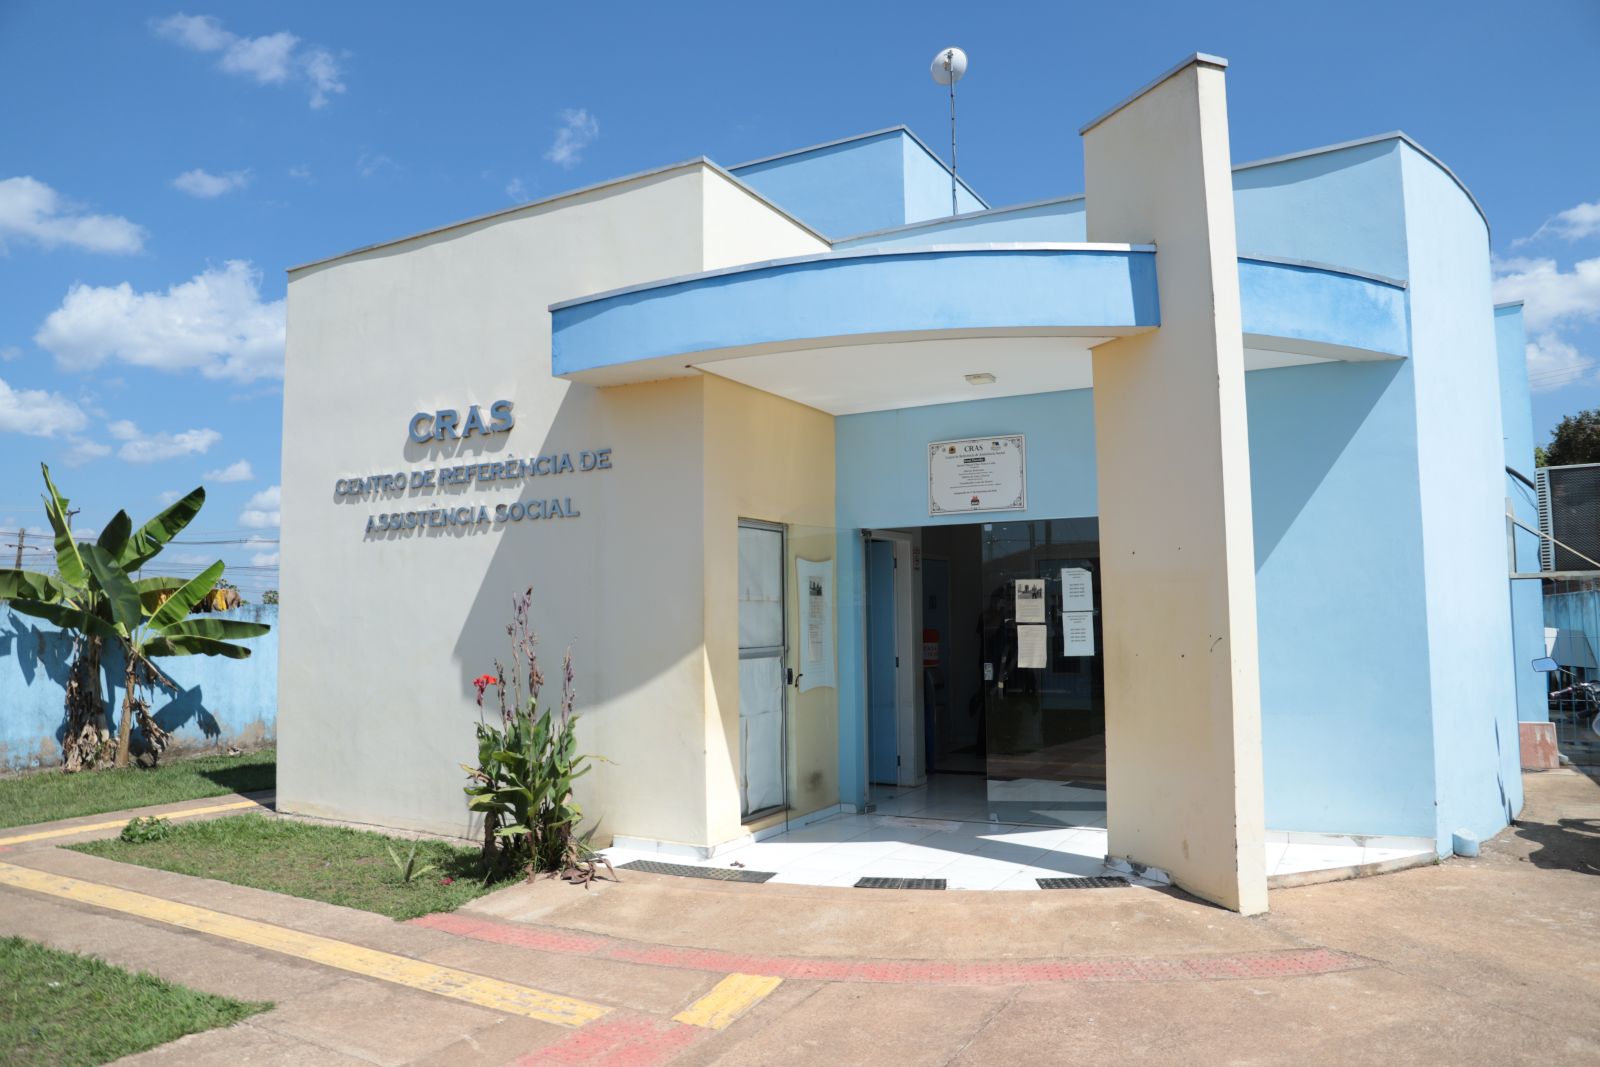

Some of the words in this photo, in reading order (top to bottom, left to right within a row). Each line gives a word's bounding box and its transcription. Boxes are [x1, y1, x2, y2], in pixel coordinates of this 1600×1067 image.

[408, 399, 515, 443] CRAS
[335, 472, 407, 496] CENTRO
[410, 470, 436, 489] DE
[439, 453, 574, 485] REFERÊNCIA
[579, 448, 613, 470] DE
[365, 503, 492, 534] ASSISTÊNCIA
[495, 497, 580, 523] SOCIAL
